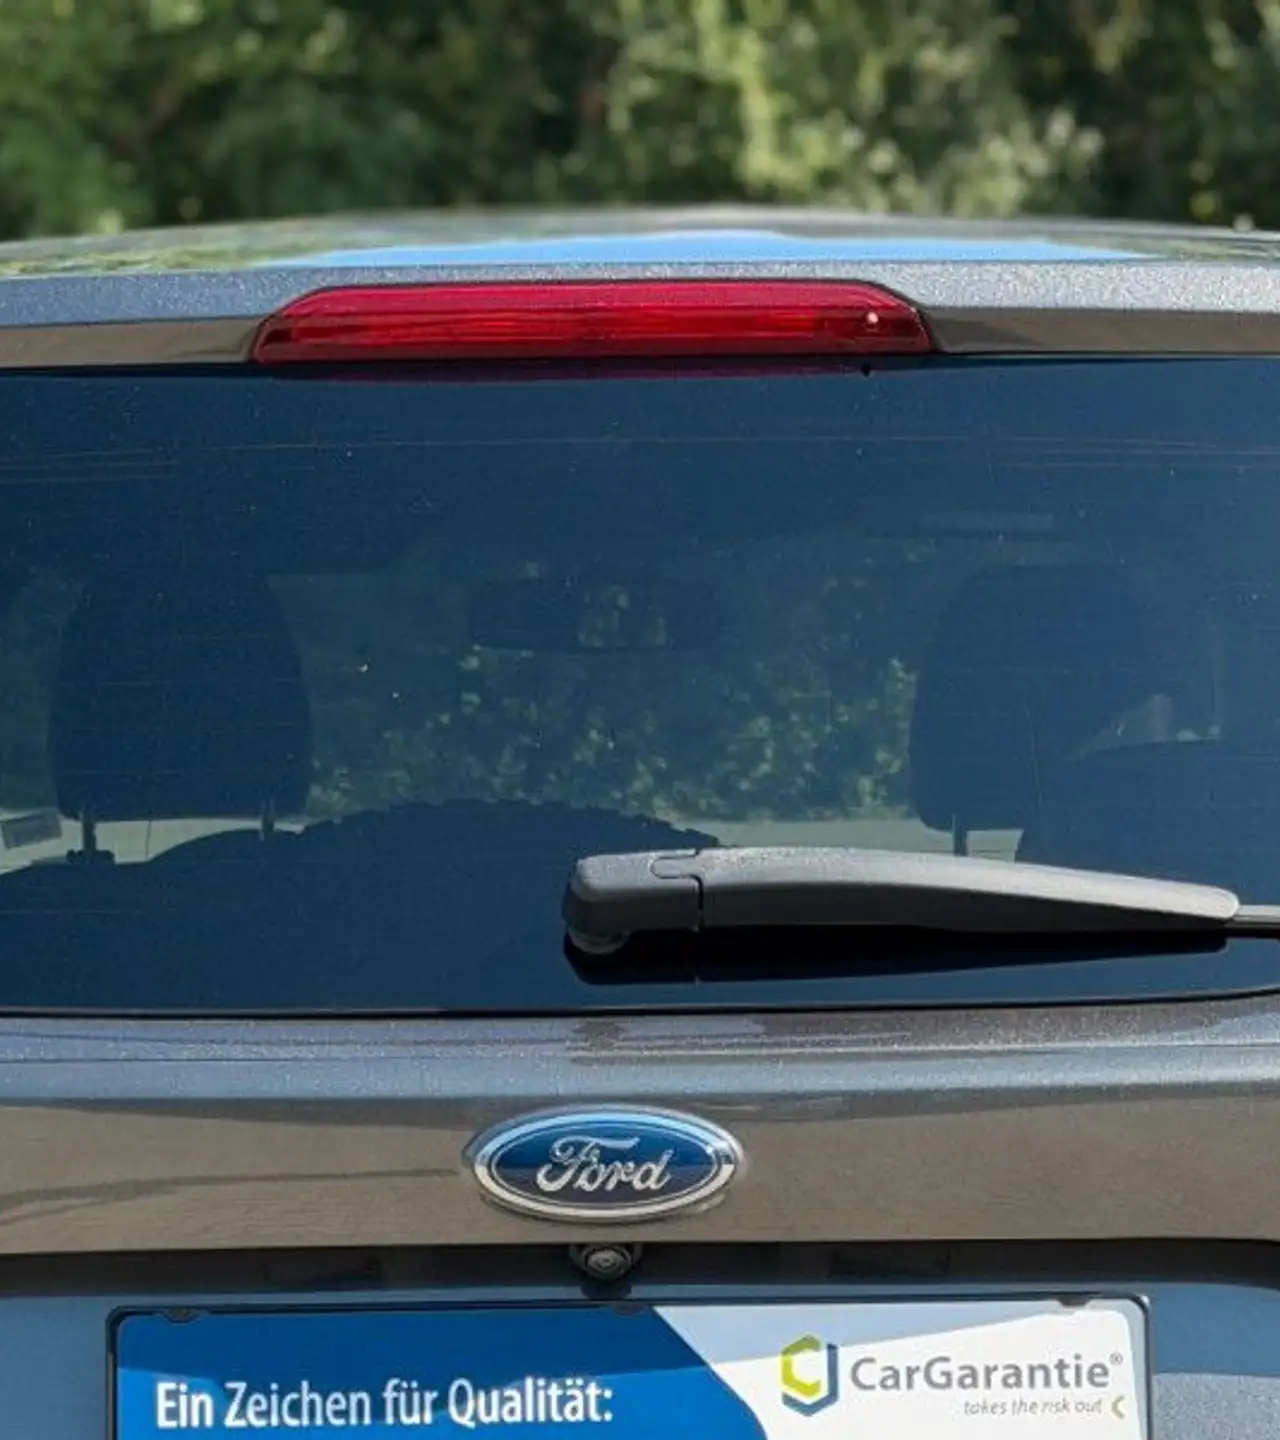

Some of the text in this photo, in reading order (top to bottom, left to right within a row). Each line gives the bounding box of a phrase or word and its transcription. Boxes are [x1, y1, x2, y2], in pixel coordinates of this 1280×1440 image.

[535, 1135, 675, 1192] Ford
[155, 1376, 615, 1429] Ein Zeichen für Qualität:
[963, 1396, 1103, 1415] takes the risk out
